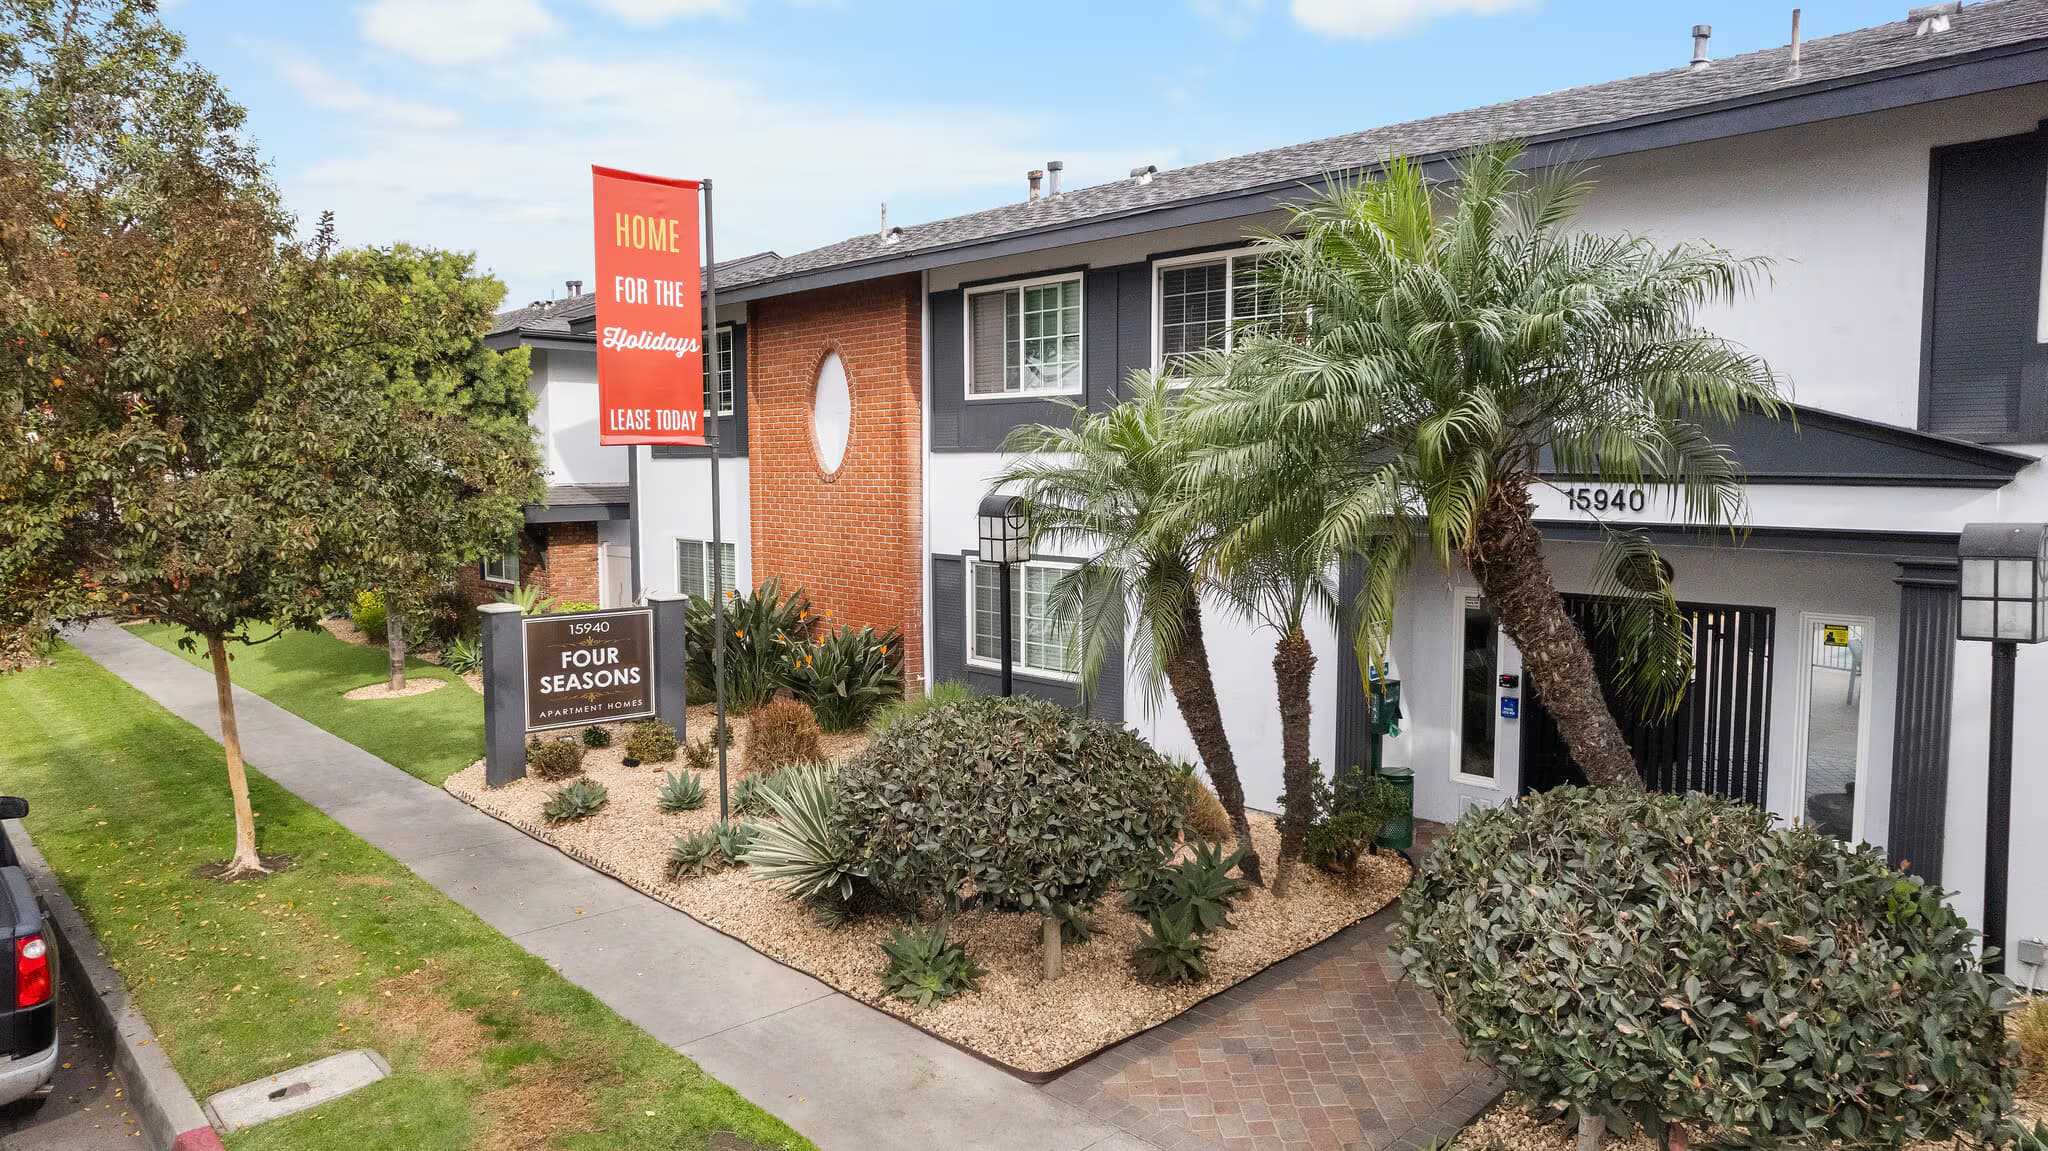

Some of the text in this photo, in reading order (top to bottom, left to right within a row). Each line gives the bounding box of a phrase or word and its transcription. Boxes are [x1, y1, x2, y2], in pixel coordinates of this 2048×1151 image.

[615, 212, 680, 253] HOME
[615, 275, 684, 308] FOR THE
[602, 326, 701, 358] Holidays
[610, 408, 698, 432] LEASE TODAY
[1563, 488, 1645, 512] 15940
[569, 621, 610, 635] 15940
[561, 647, 619, 669] FOUR
[540, 667, 641, 694] SEASONS
[539, 699, 643, 719] APARTMENT HOMES
